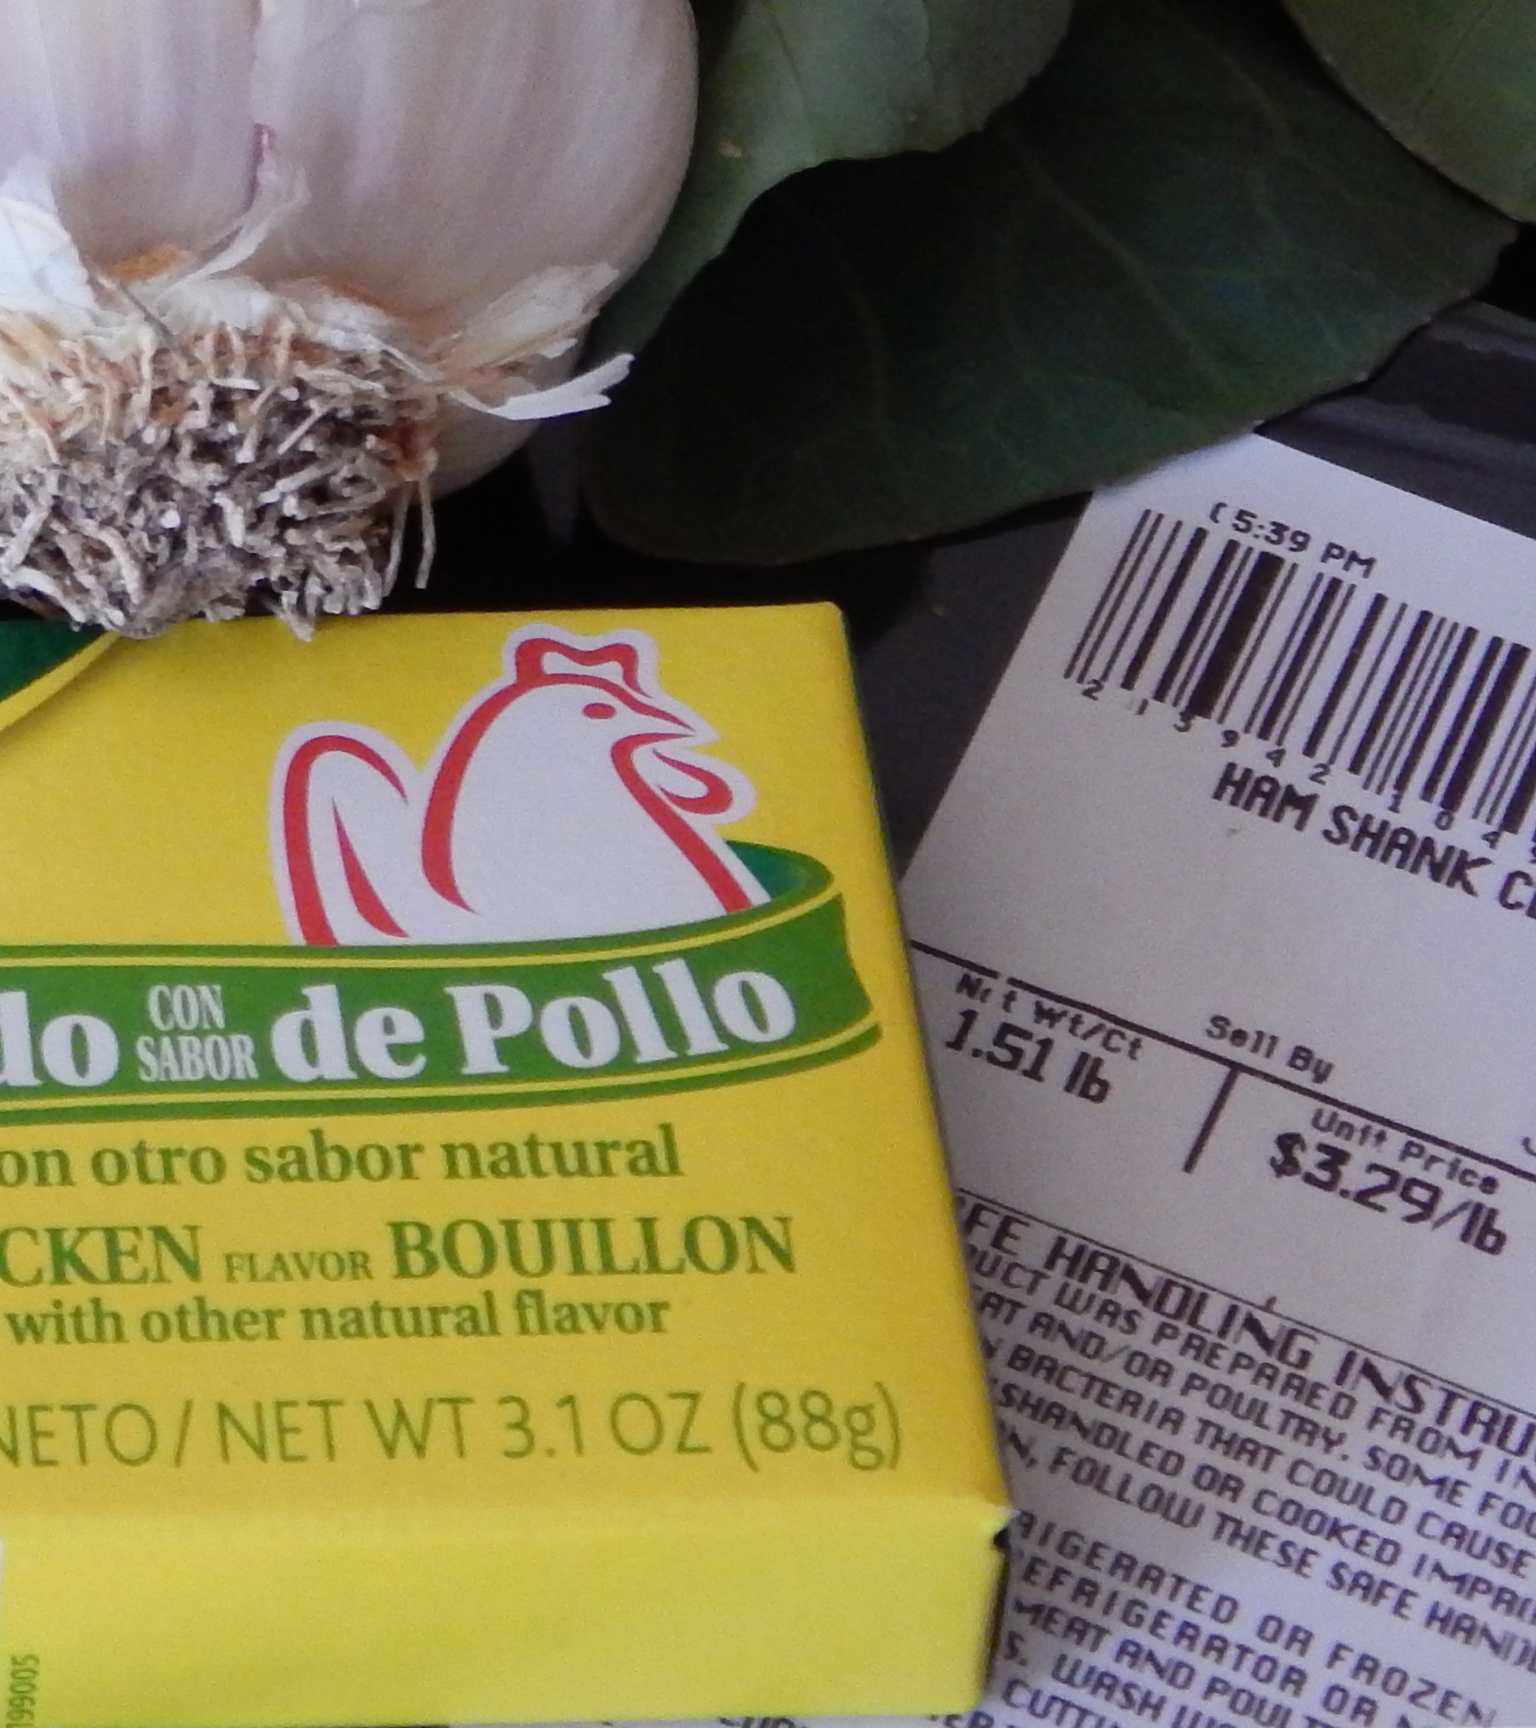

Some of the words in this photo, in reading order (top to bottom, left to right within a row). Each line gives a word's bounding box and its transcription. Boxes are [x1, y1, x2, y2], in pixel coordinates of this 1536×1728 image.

[1321, 540, 1377, 579] PM
[1212, 761, 1319, 832] HAM
[1323, 804, 1493, 899] SHANK
[134, 1034, 259, 1084] SABOR
[147, 983, 226, 1031] CON
[270, 983, 428, 1084] de
[444, 958, 797, 1075] Pollo
[945, 1009, 1056, 1084] 1.51
[1063, 1051, 1113, 1106] lb
[1034, 999, 1145, 1062] Wt/Ct
[1207, 1013, 1277, 1062] Sell
[1287, 1045, 1336, 1085] By
[90, 1138, 227, 1187] otro
[245, 1128, 425, 1185] sabor
[440, 1122, 686, 1180] natural
[1270, 1131, 1507, 1257] $3.29/lb
[1311, 1107, 1388, 1153] Unit
[1398, 1138, 1501, 1195] Price
[223, 1248, 373, 1285] FLAVOR
[386, 1214, 798, 1281] BOUILLON
[4, 1295, 130, 1346] with
[140, 1294, 286, 1344] other
[300, 1289, 502, 1341] natural
[512, 1287, 671, 1337] flavor
[1043, 1235, 1320, 1370] HANDLING
[1027, 1311, 1176, 1388] AND/OR
[1179, 1372, 1350, 1462] POULTRY.
[1363, 1444, 1472, 1509] SOME
[1054, 1281, 1144, 1335] WAS
[1151, 1321, 1358, 1420] PREPARED
[1366, 1406, 1484, 1471] FROM
[216, 1398, 344, 1464] NET
[364, 1394, 477, 1461] WT
[496, 1393, 585, 1459] 3.1
[608, 1390, 713, 1456] OZ
[731, 1381, 902, 1473] (88g)
[1006, 1343, 1186, 1436] BACTERIA
[1194, 1416, 1285, 1473] THAT
[1285, 1458, 1409, 1525] COULD
[1415, 1510, 1535, 1580] CAUSE
[1048, 1446, 1206, 1529] FOLLOW
[1211, 1510, 1321, 1580] THESE
[1326, 1560, 1421, 1621] SAFE
[1192, 1463, 1246, 1504] OR
[1251, 1487, 1403, 1567] COOKED
[1050, 1653, 1168, 1722] WASH
[1114, 1638, 1196, 1691] AND
[1256, 1613, 1315, 1658] OR
[1326, 1642, 1497, 1724] FROZEN
[1321, 1682, 1379, 1728] OR
